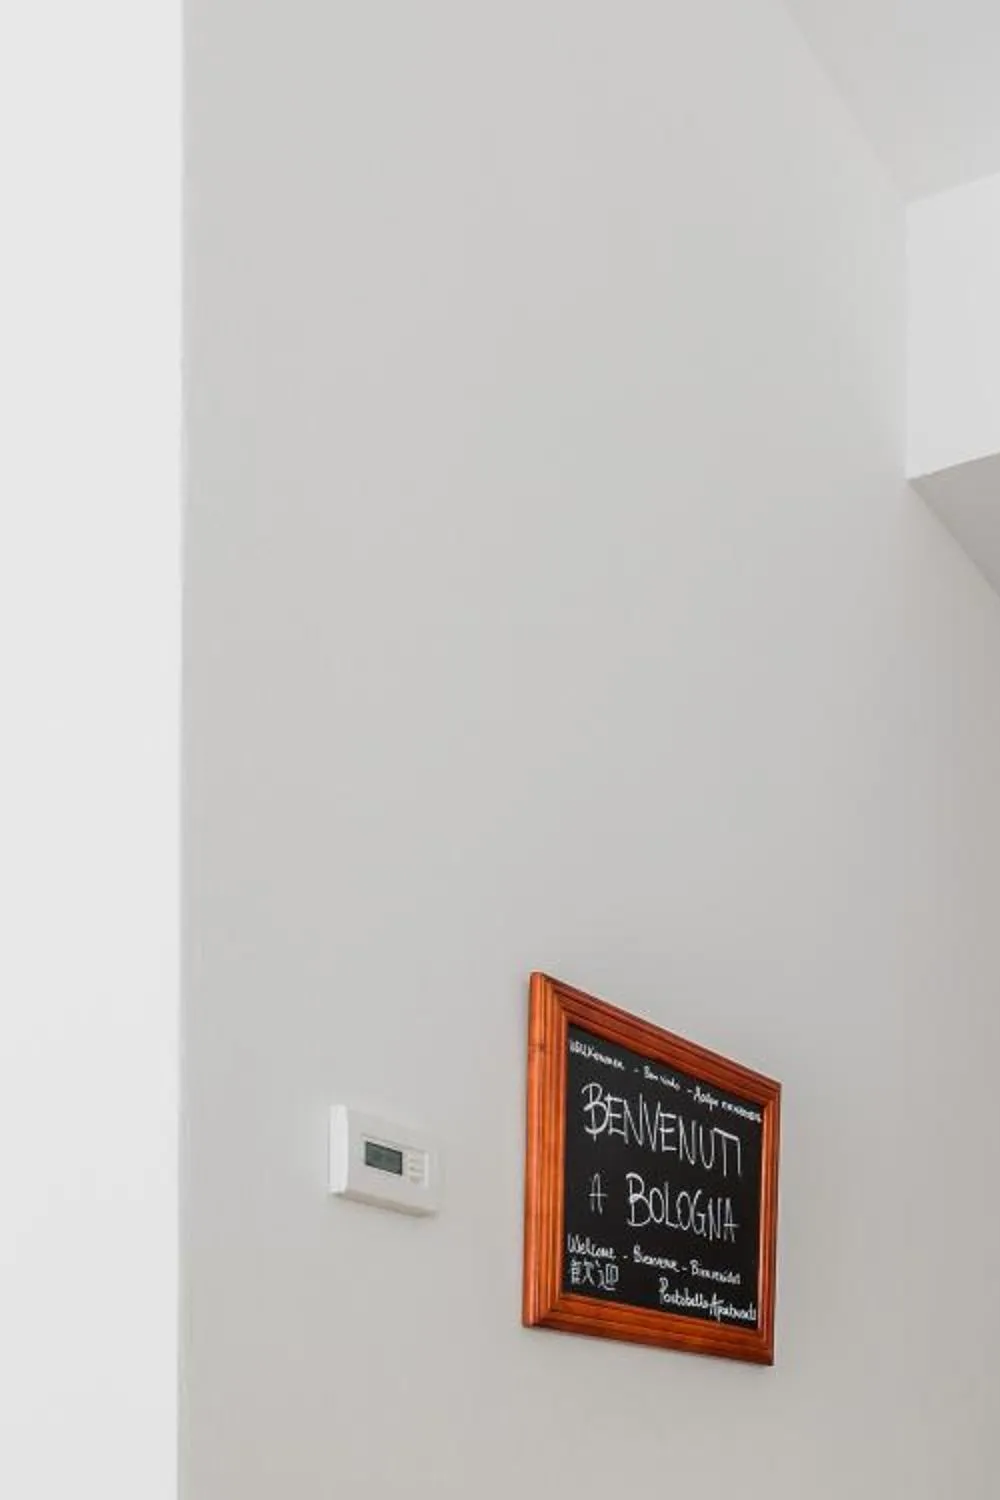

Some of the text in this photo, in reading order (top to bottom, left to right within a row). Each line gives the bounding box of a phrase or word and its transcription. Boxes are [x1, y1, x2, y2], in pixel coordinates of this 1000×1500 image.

[581, 1081, 743, 1178] BENVENUTI
[588, 1171, 739, 1244] A BOLOGNA
[567, 1232, 617, 1260] Welcome
